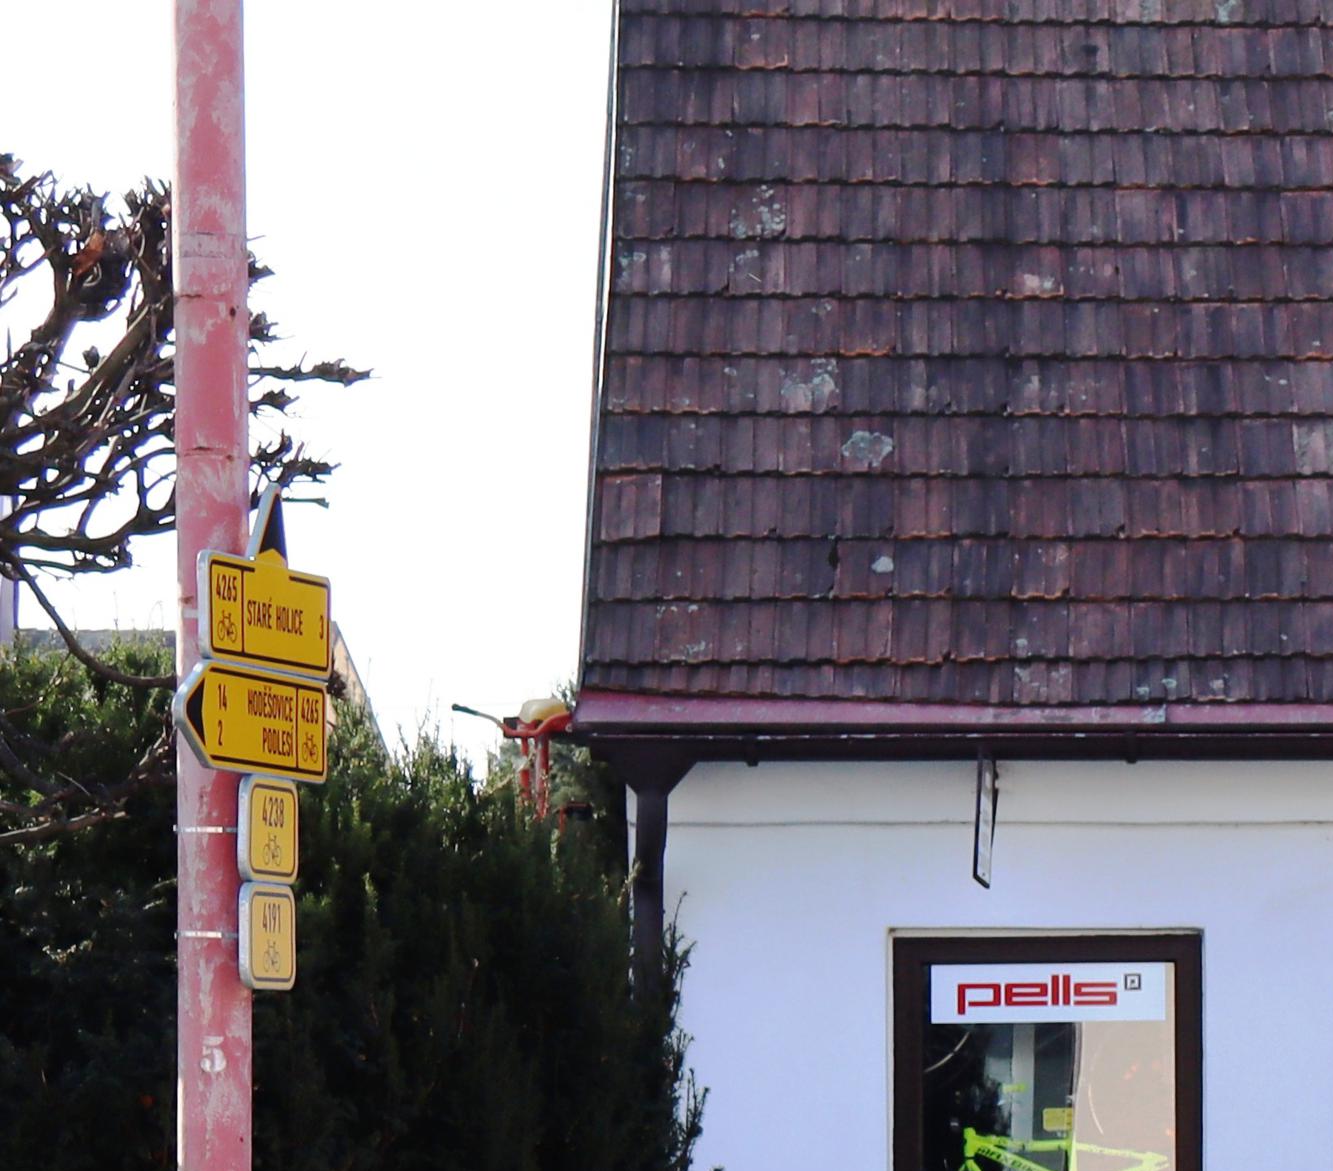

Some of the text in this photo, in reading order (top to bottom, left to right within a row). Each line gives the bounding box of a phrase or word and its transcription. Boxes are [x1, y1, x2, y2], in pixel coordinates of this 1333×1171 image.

[216, 573, 238, 602] 4265
[247, 597, 324, 640] STARÉ HOLICE 3
[218, 683, 227, 712] 14
[301, 696, 319, 725] 4265
[218, 719, 293, 757] 2 PODLESÍ
[262, 796, 285, 829] 4238
[262, 903, 281, 934] 4191
[957, 974, 1118, 1015] pells
[200, 1035, 227, 1072] 5
